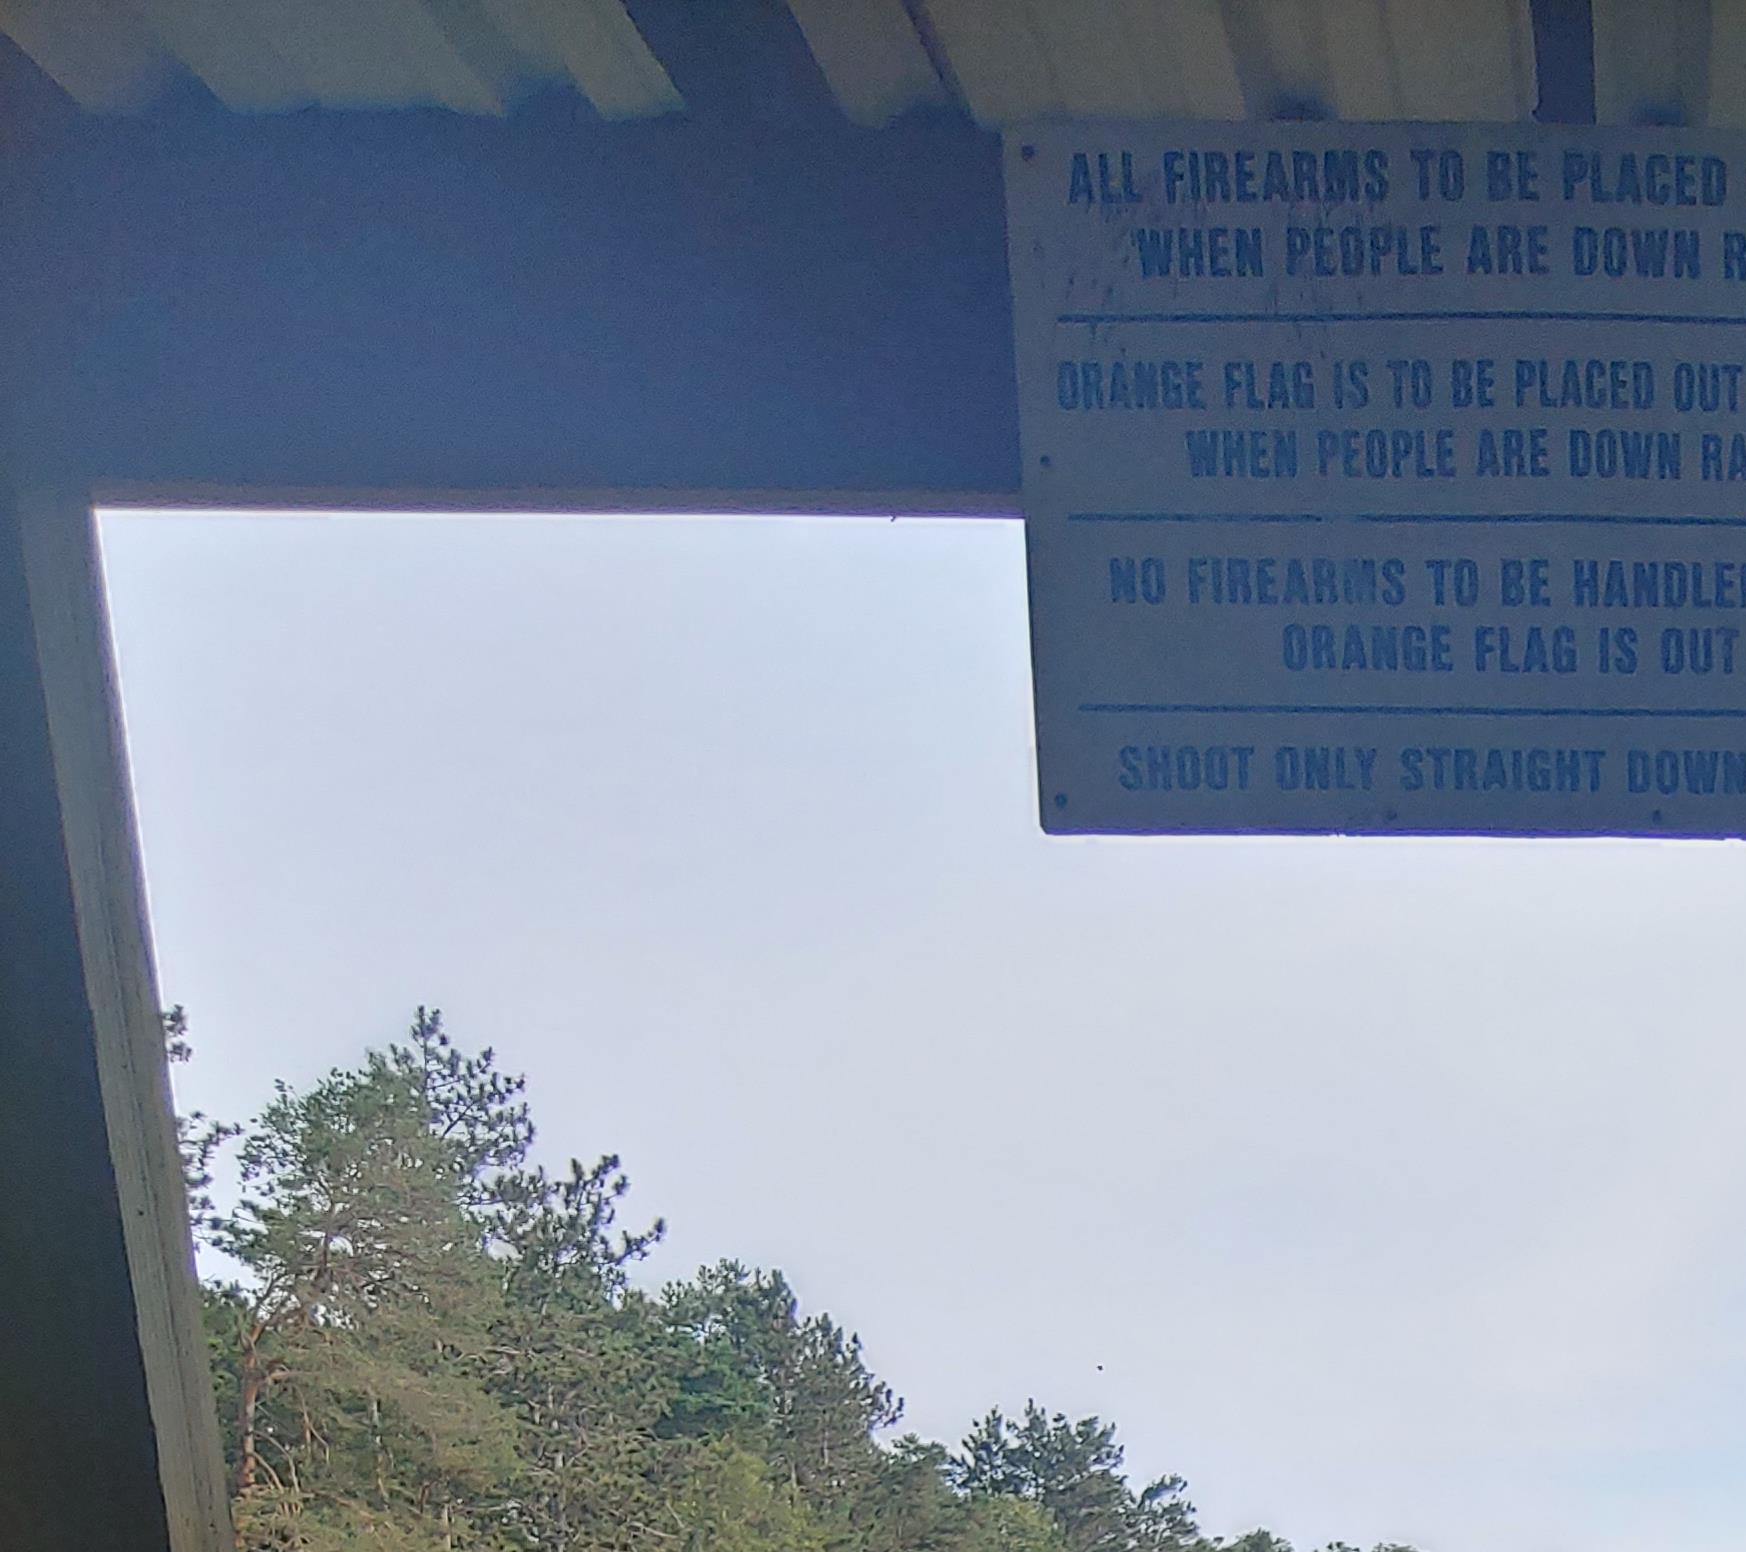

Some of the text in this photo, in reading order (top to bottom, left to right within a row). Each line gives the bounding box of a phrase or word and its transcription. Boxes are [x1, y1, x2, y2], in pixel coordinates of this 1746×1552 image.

[1069, 151, 1142, 204] ALL
[1163, 149, 1388, 204] FIREARMS
[1410, 148, 1464, 202] TO
[1486, 149, 1540, 202] BE
[1563, 149, 1727, 207] PLACED
[1136, 226, 1265, 279] WHEN
[1286, 225, 1443, 277] PEOPLE
[1466, 223, 1550, 276] ARE
[1573, 226, 1700, 280] DOWN
[1056, 359, 1204, 411] ORANGE
[1223, 359, 1315, 409] FLAG
[1333, 359, 1370, 410] IS
[1387, 358, 1432, 409] TO
[1452, 358, 1496, 409] BE
[1514, 358, 1653, 412] PLACED
[1673, 362, 1743, 414] OUT
[1185, 428, 1298, 479] WHEN
[1317, 428, 1456, 479] PEOPLE
[1475, 428, 1551, 479] ARE
[1569, 428, 1682, 480] DOWN
[1109, 557, 1166, 605] NO
[1188, 557, 1407, 607] FIREARMS
[1425, 558, 1480, 608] TO
[1500, 558, 1551, 608] BE
[1282, 623, 1741, 676] ORANGE FLAG IS OUT
[1117, 746, 1255, 792] SHOOT
[1274, 746, 1378, 793] ONLY
[1400, 748, 1606, 795] STRAIGHT
